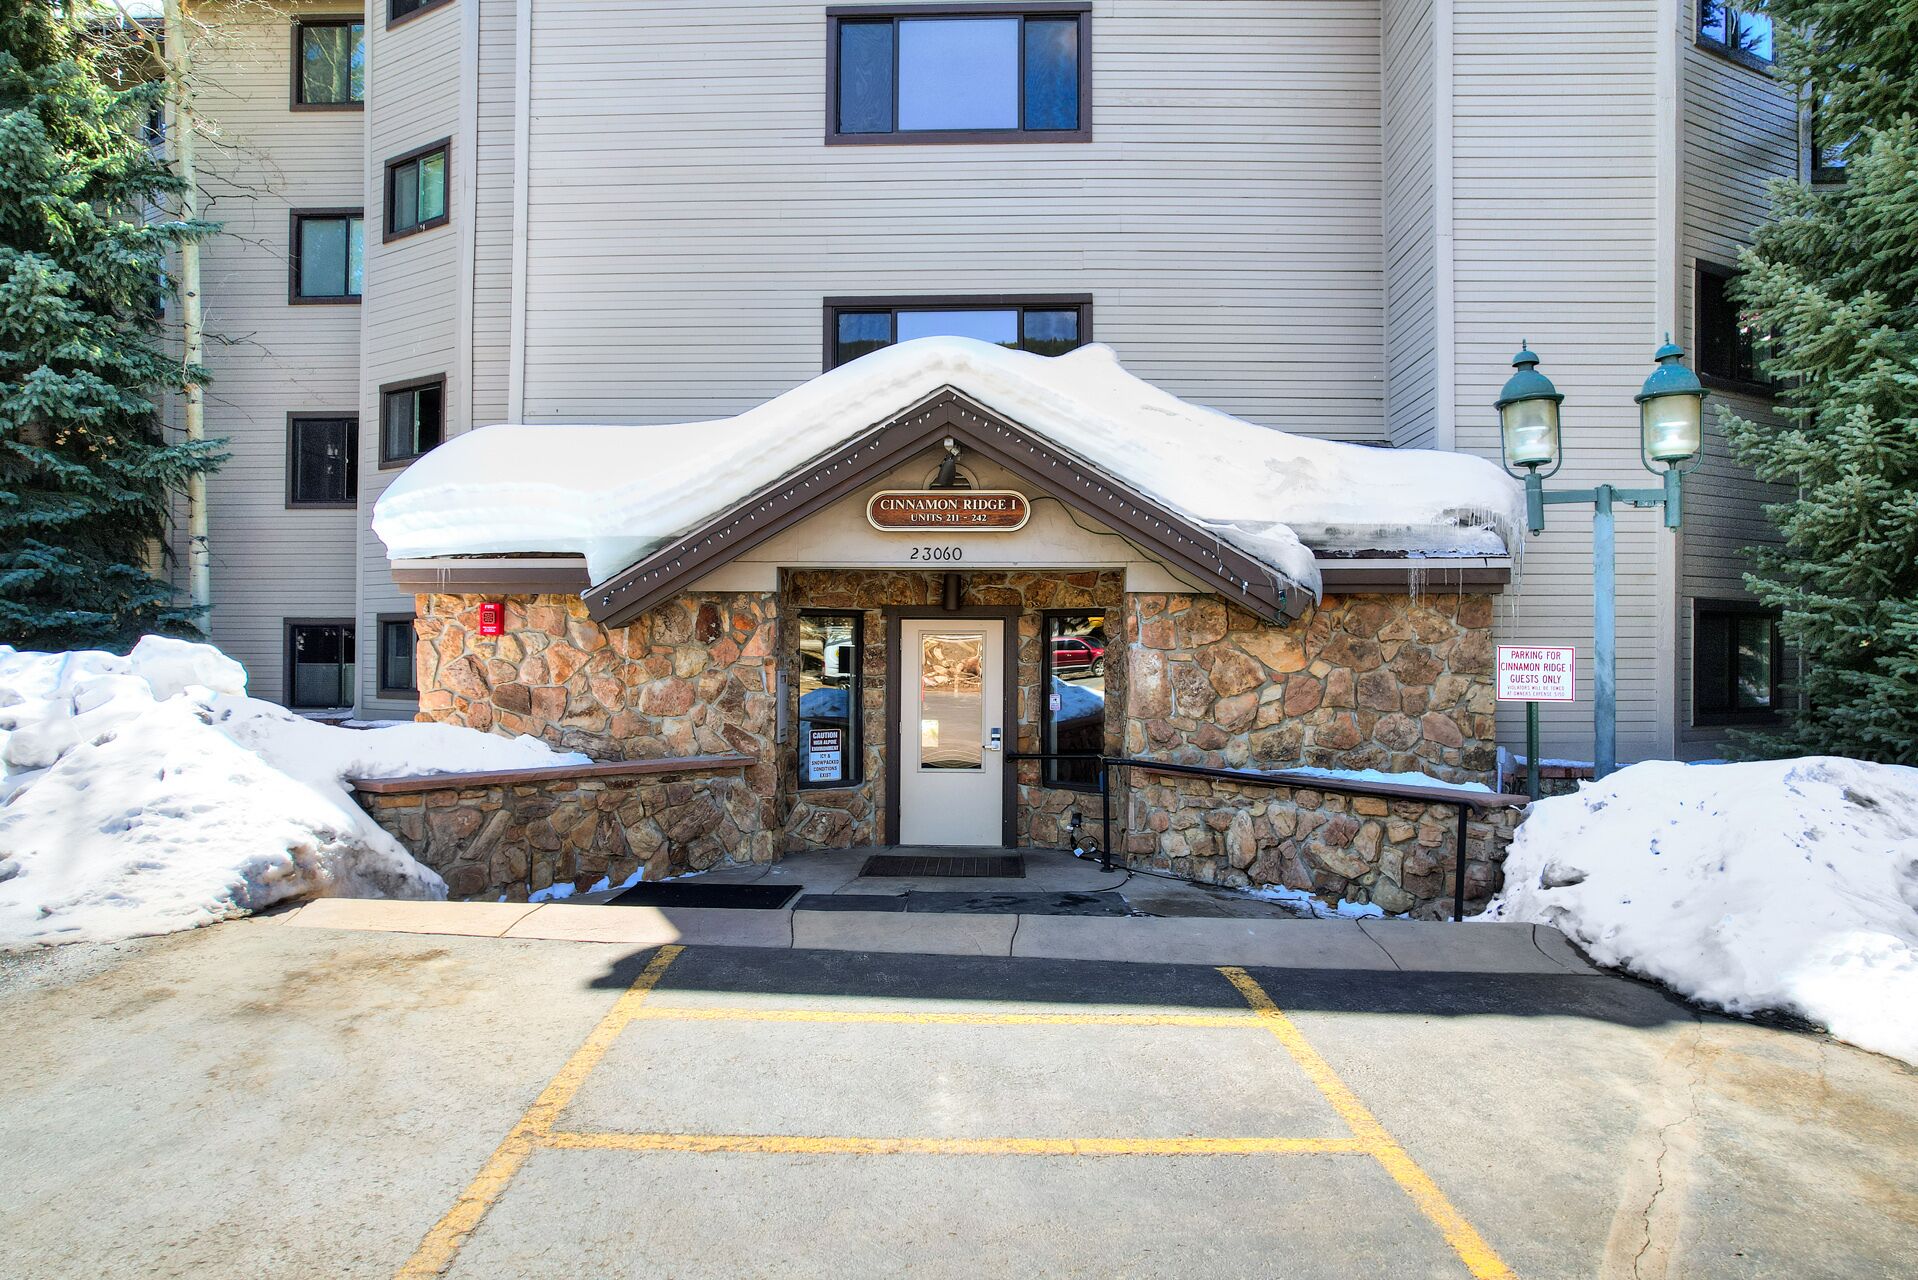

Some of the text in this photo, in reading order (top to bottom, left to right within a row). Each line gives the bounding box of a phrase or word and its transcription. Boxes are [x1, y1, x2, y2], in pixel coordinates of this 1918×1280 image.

[880, 499, 958, 510] CINNAMON
[963, 499, 1006, 510] RIDGE
[910, 513, 943, 522] UNITS
[946, 514, 960, 522] 211
[971, 514, 988, 522] 242
[910, 547, 963, 561] 23060
[1511, 650, 1561, 660] PARKING FOR
[1500, 662, 1540, 672] CINNAMON
[1543, 663, 1566, 673] RIDGE
[1510, 674, 1562, 684] GUESTS ONLY
